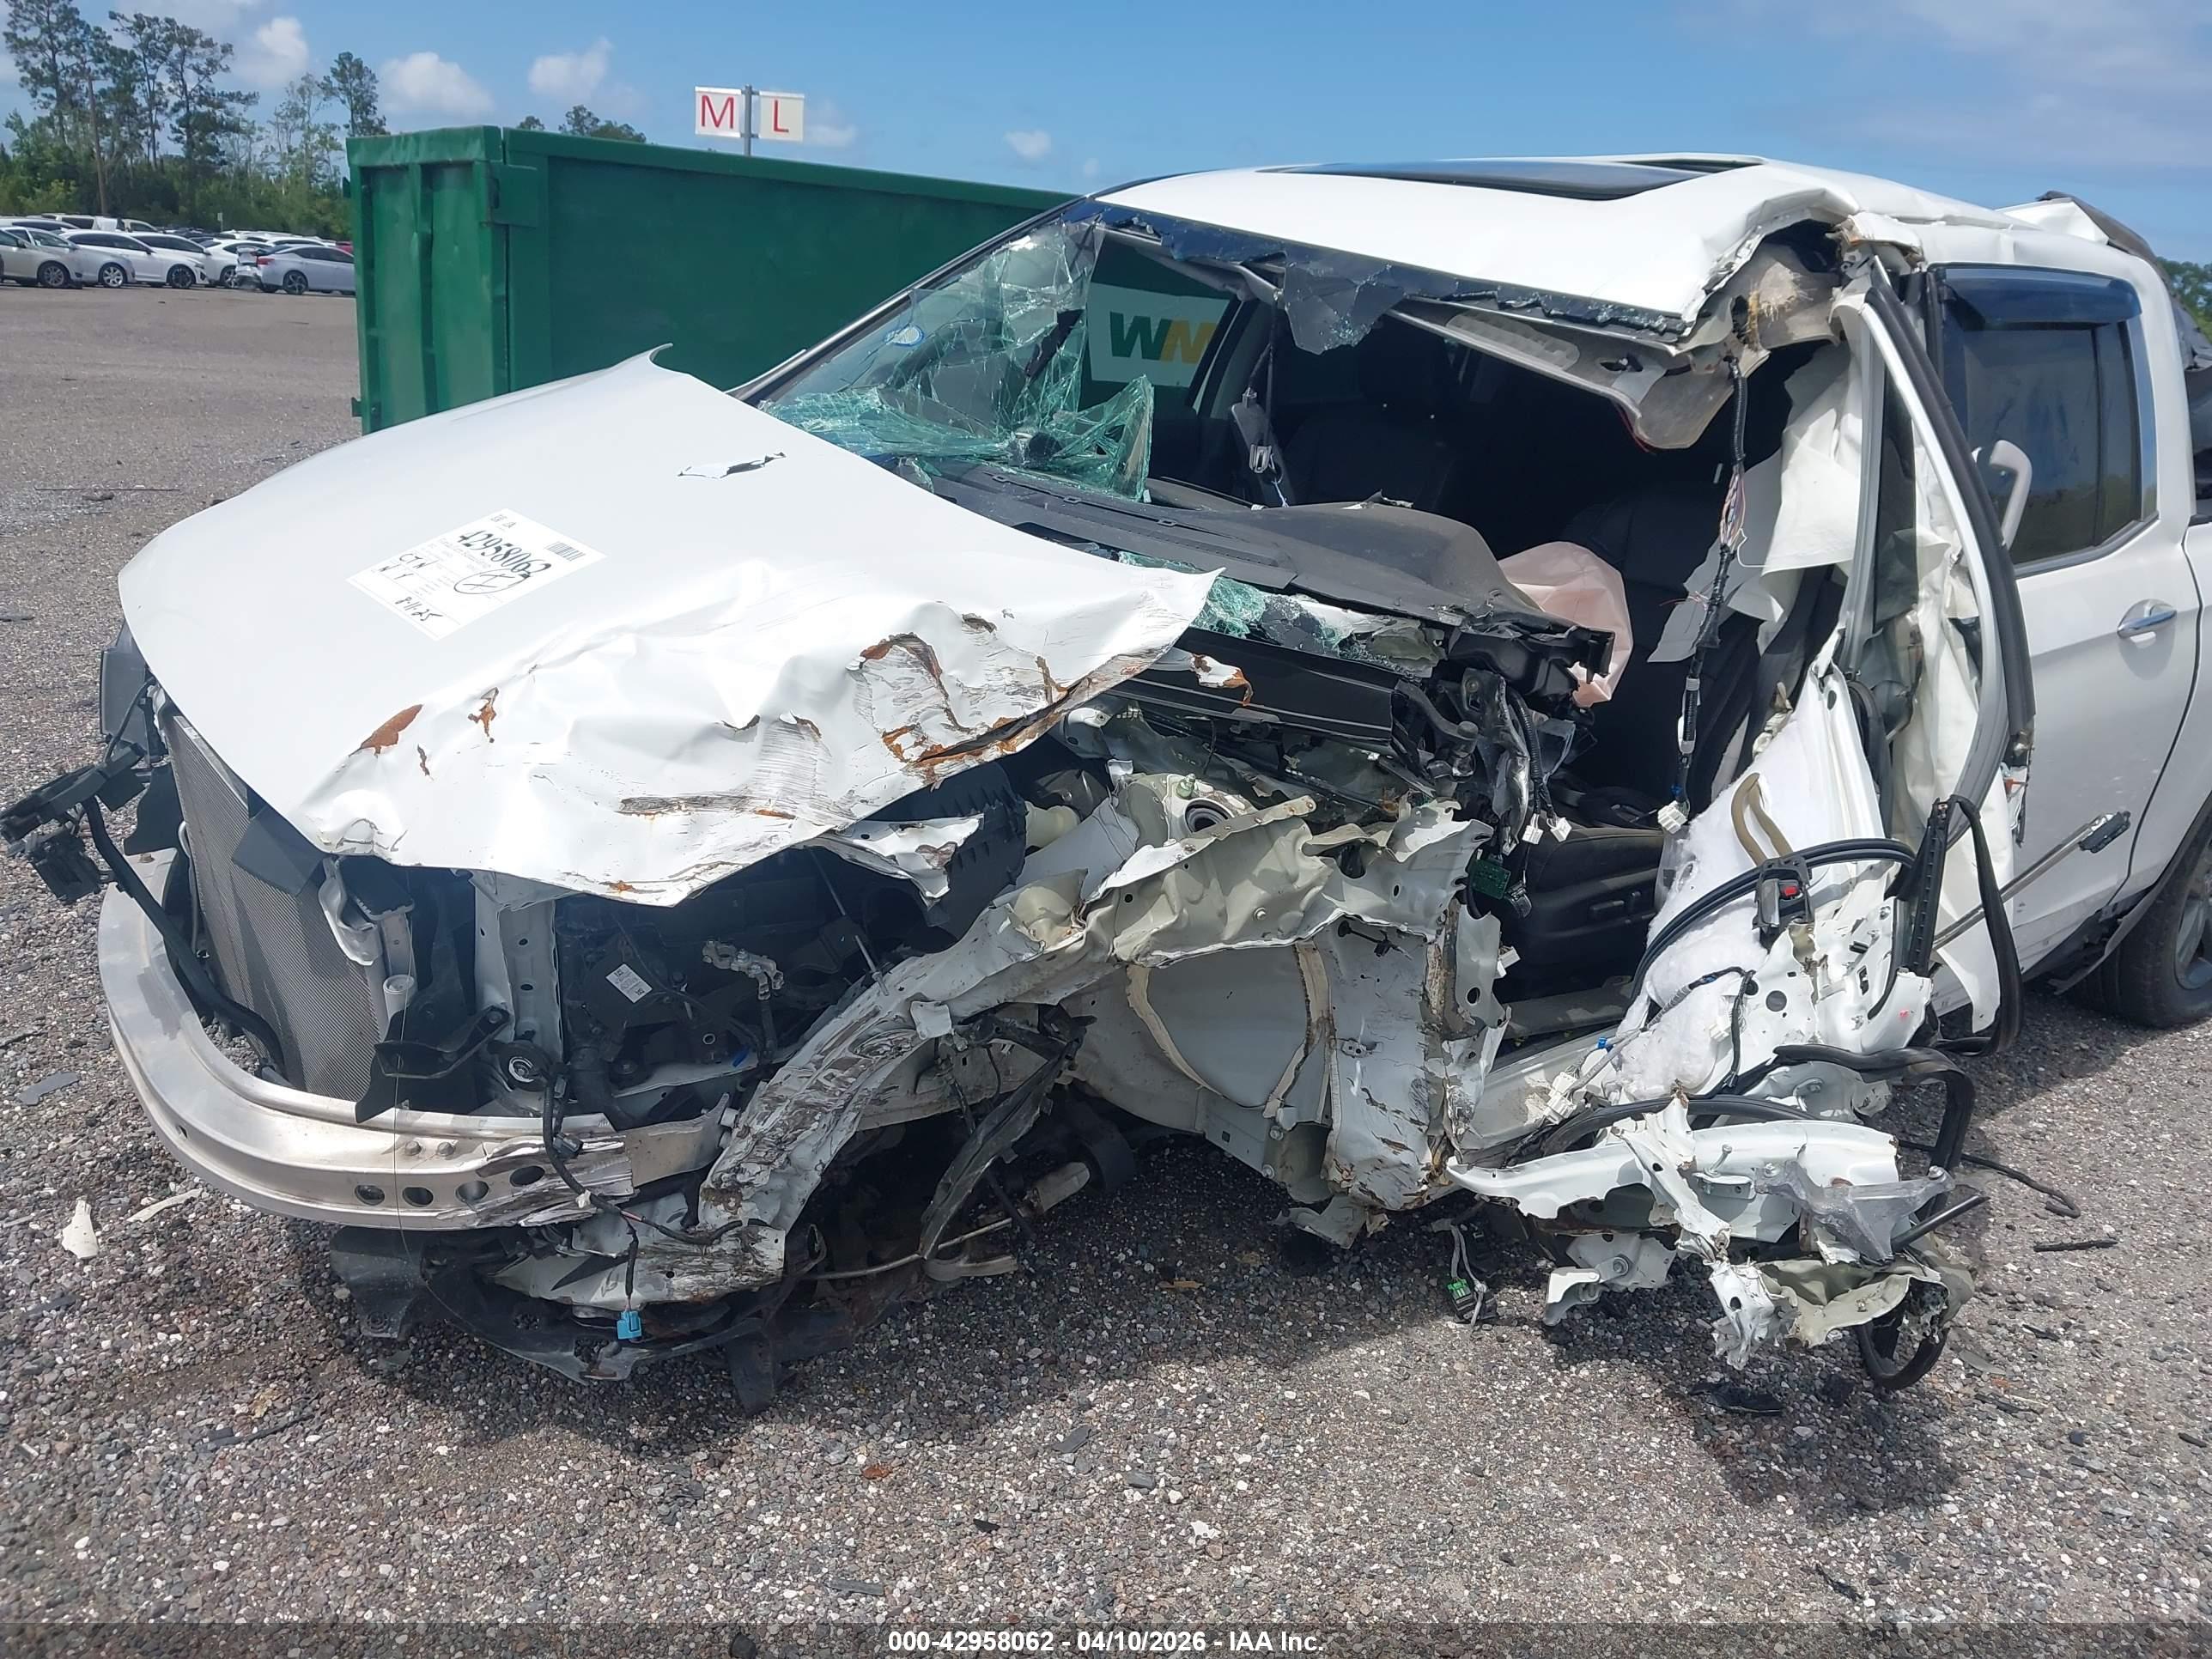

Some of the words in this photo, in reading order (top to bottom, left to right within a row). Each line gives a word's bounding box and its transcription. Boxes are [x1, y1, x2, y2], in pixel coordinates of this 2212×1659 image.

[701, 94, 734, 129] M
[773, 100, 789, 132] L
[457, 530, 552, 579] 42958062
